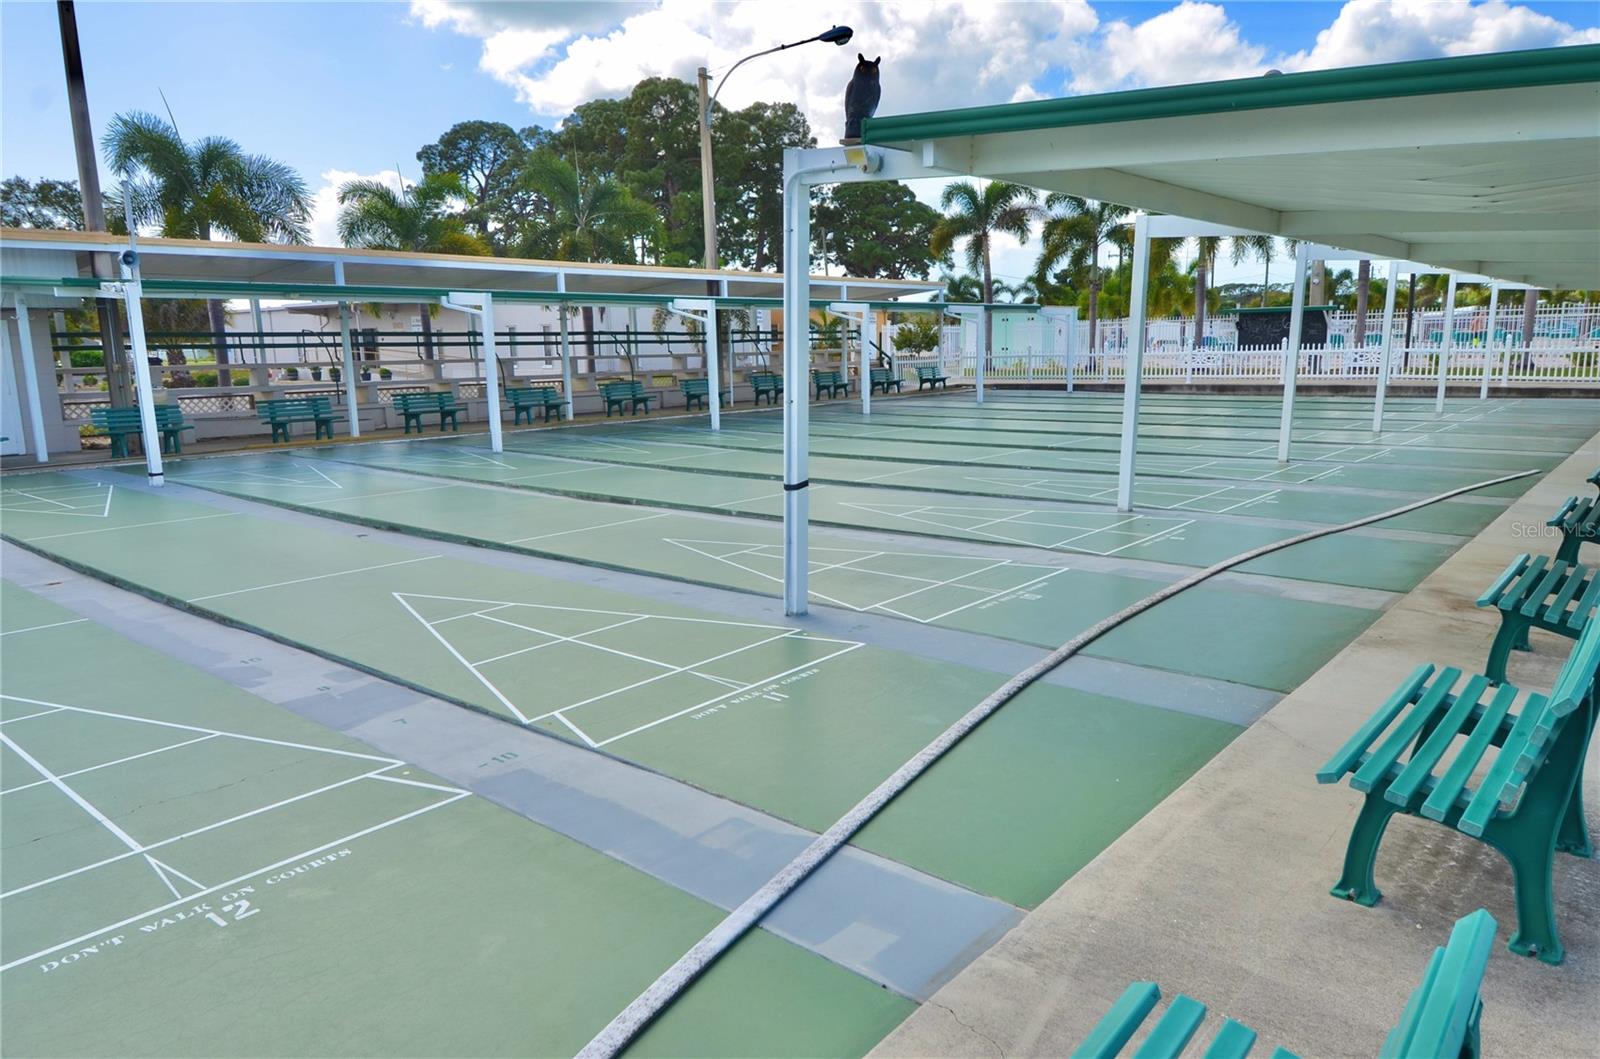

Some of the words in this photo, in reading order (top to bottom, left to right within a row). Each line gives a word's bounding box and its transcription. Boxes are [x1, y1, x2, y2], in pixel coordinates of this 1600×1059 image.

[762, 692, 790, 701] 11
[39, 934, 125, 973] DON'T
[139, 902, 212, 932] WALK
[222, 885, 255, 901] ON
[265, 848, 352, 885] COURTS
[204, 899, 261, 927] 12
